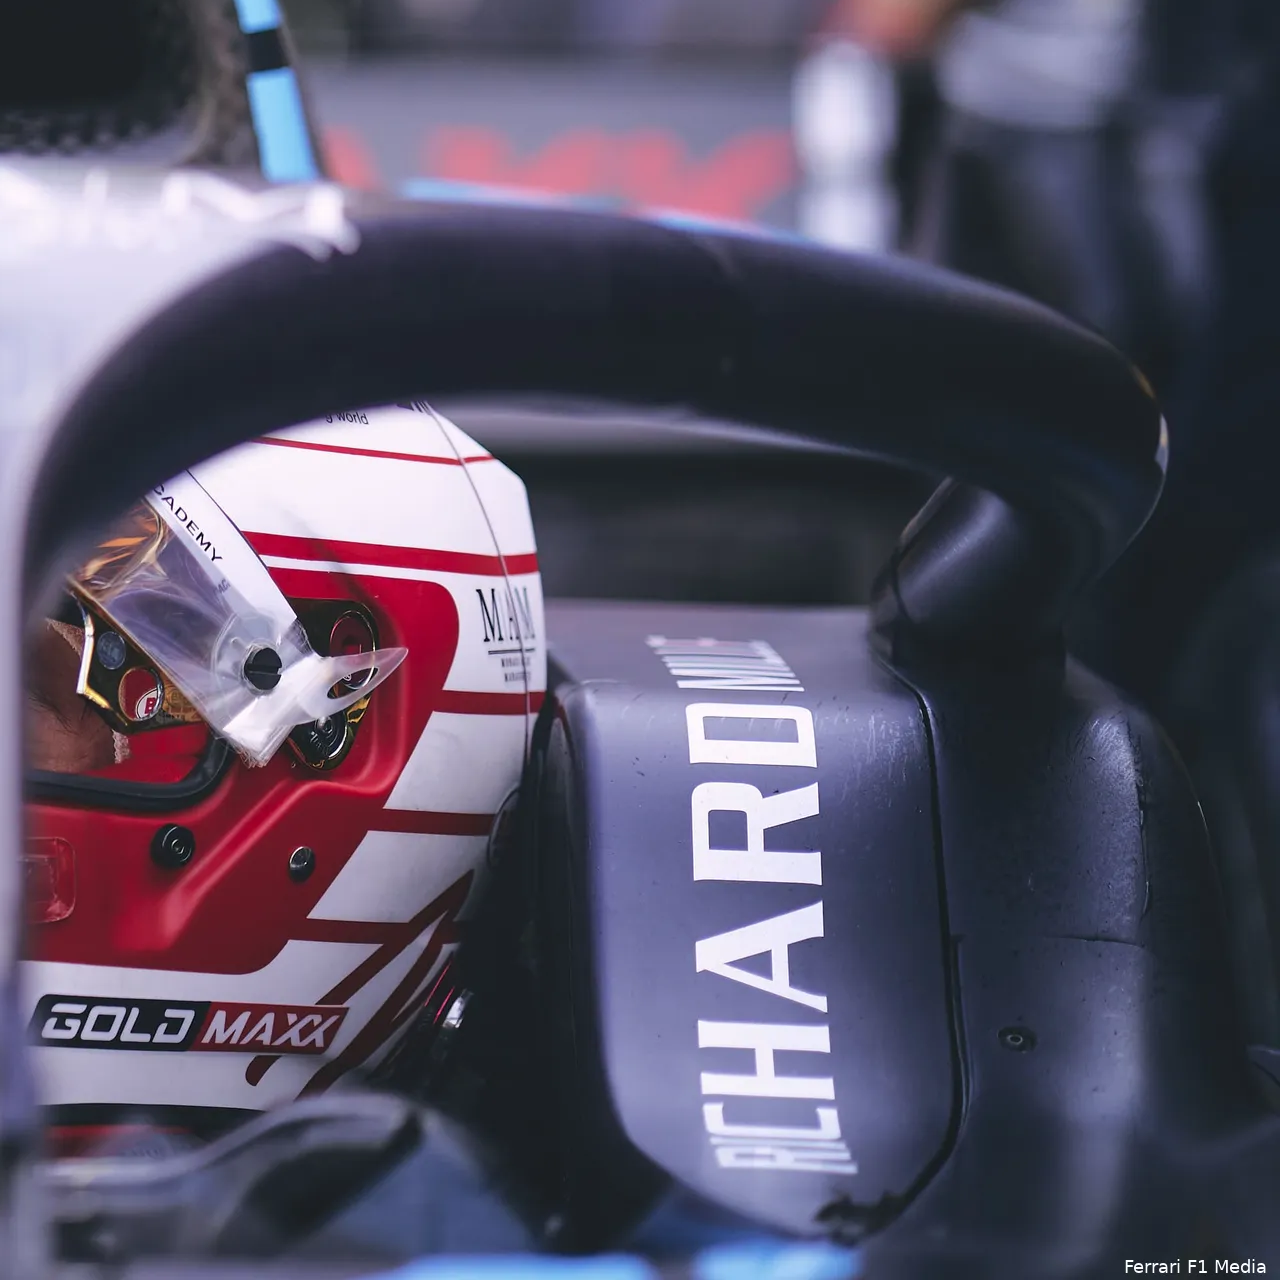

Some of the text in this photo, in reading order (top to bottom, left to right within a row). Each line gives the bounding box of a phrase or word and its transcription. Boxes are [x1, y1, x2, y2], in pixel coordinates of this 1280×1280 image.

[153, 483, 224, 562] CADEMY
[685, 702, 859, 1175] RICHARD
[41, 1003, 340, 1048] GOLD MAXX
